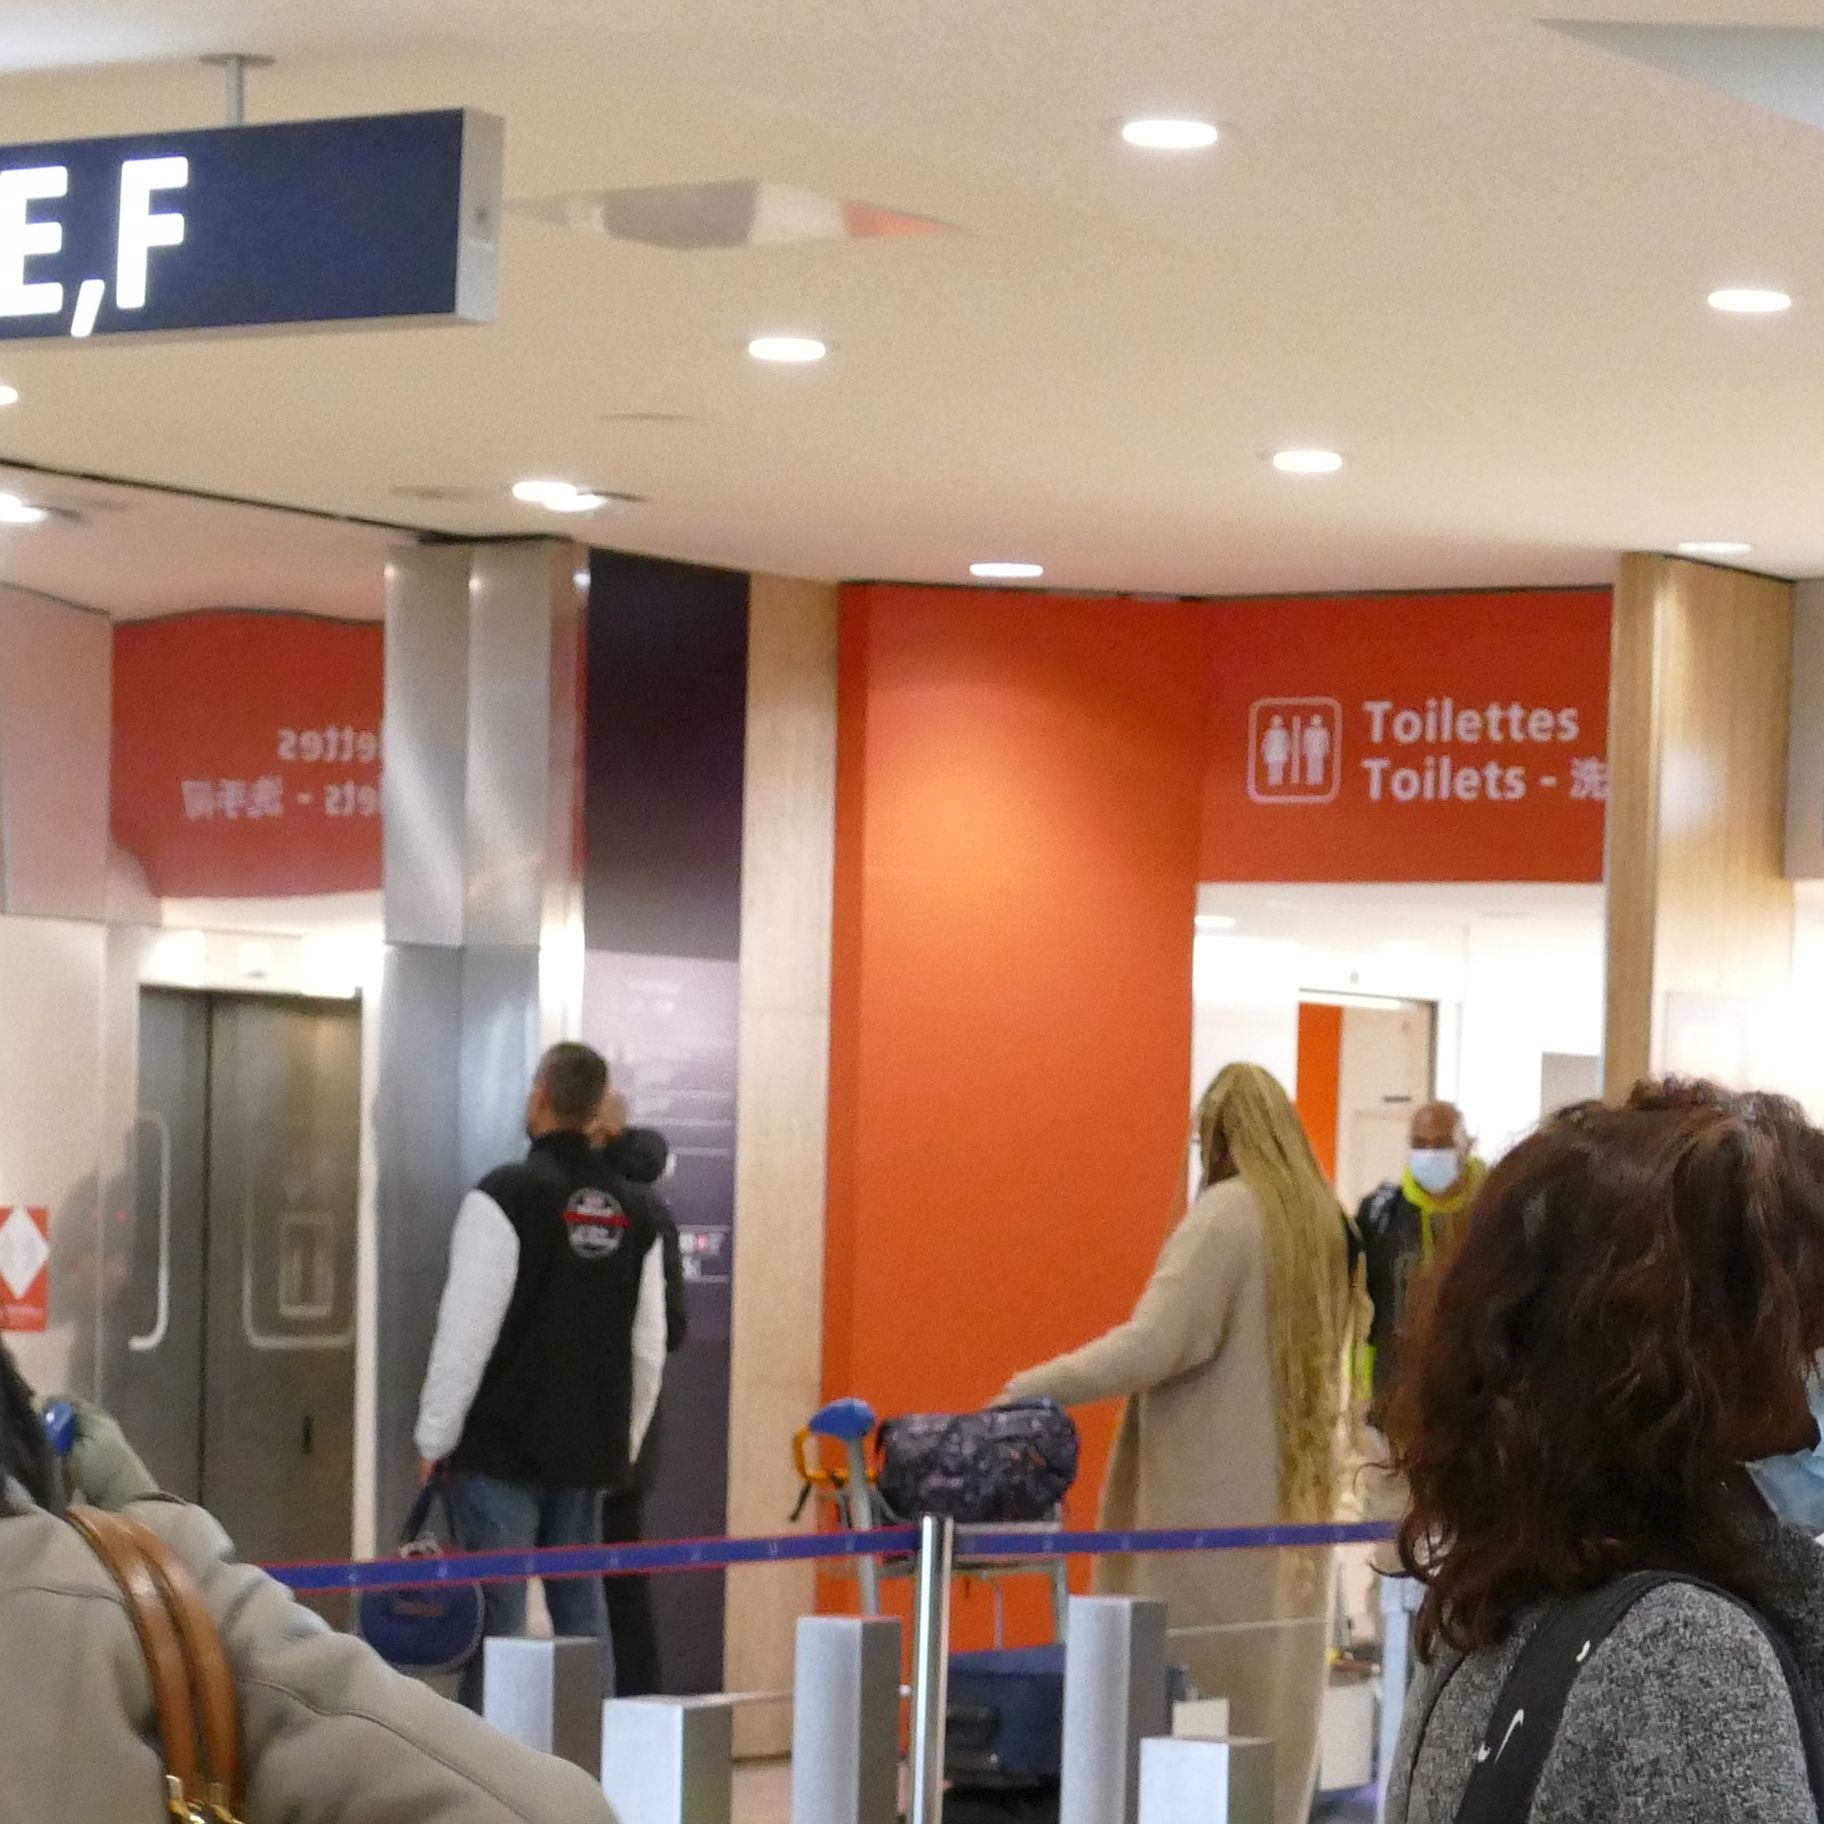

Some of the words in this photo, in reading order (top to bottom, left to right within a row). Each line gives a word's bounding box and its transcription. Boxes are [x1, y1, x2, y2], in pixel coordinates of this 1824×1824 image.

[1362, 697, 1580, 744] Toilettes
[1360, 754, 1527, 801] Toilets
[1539, 775, 1557, 788] -
